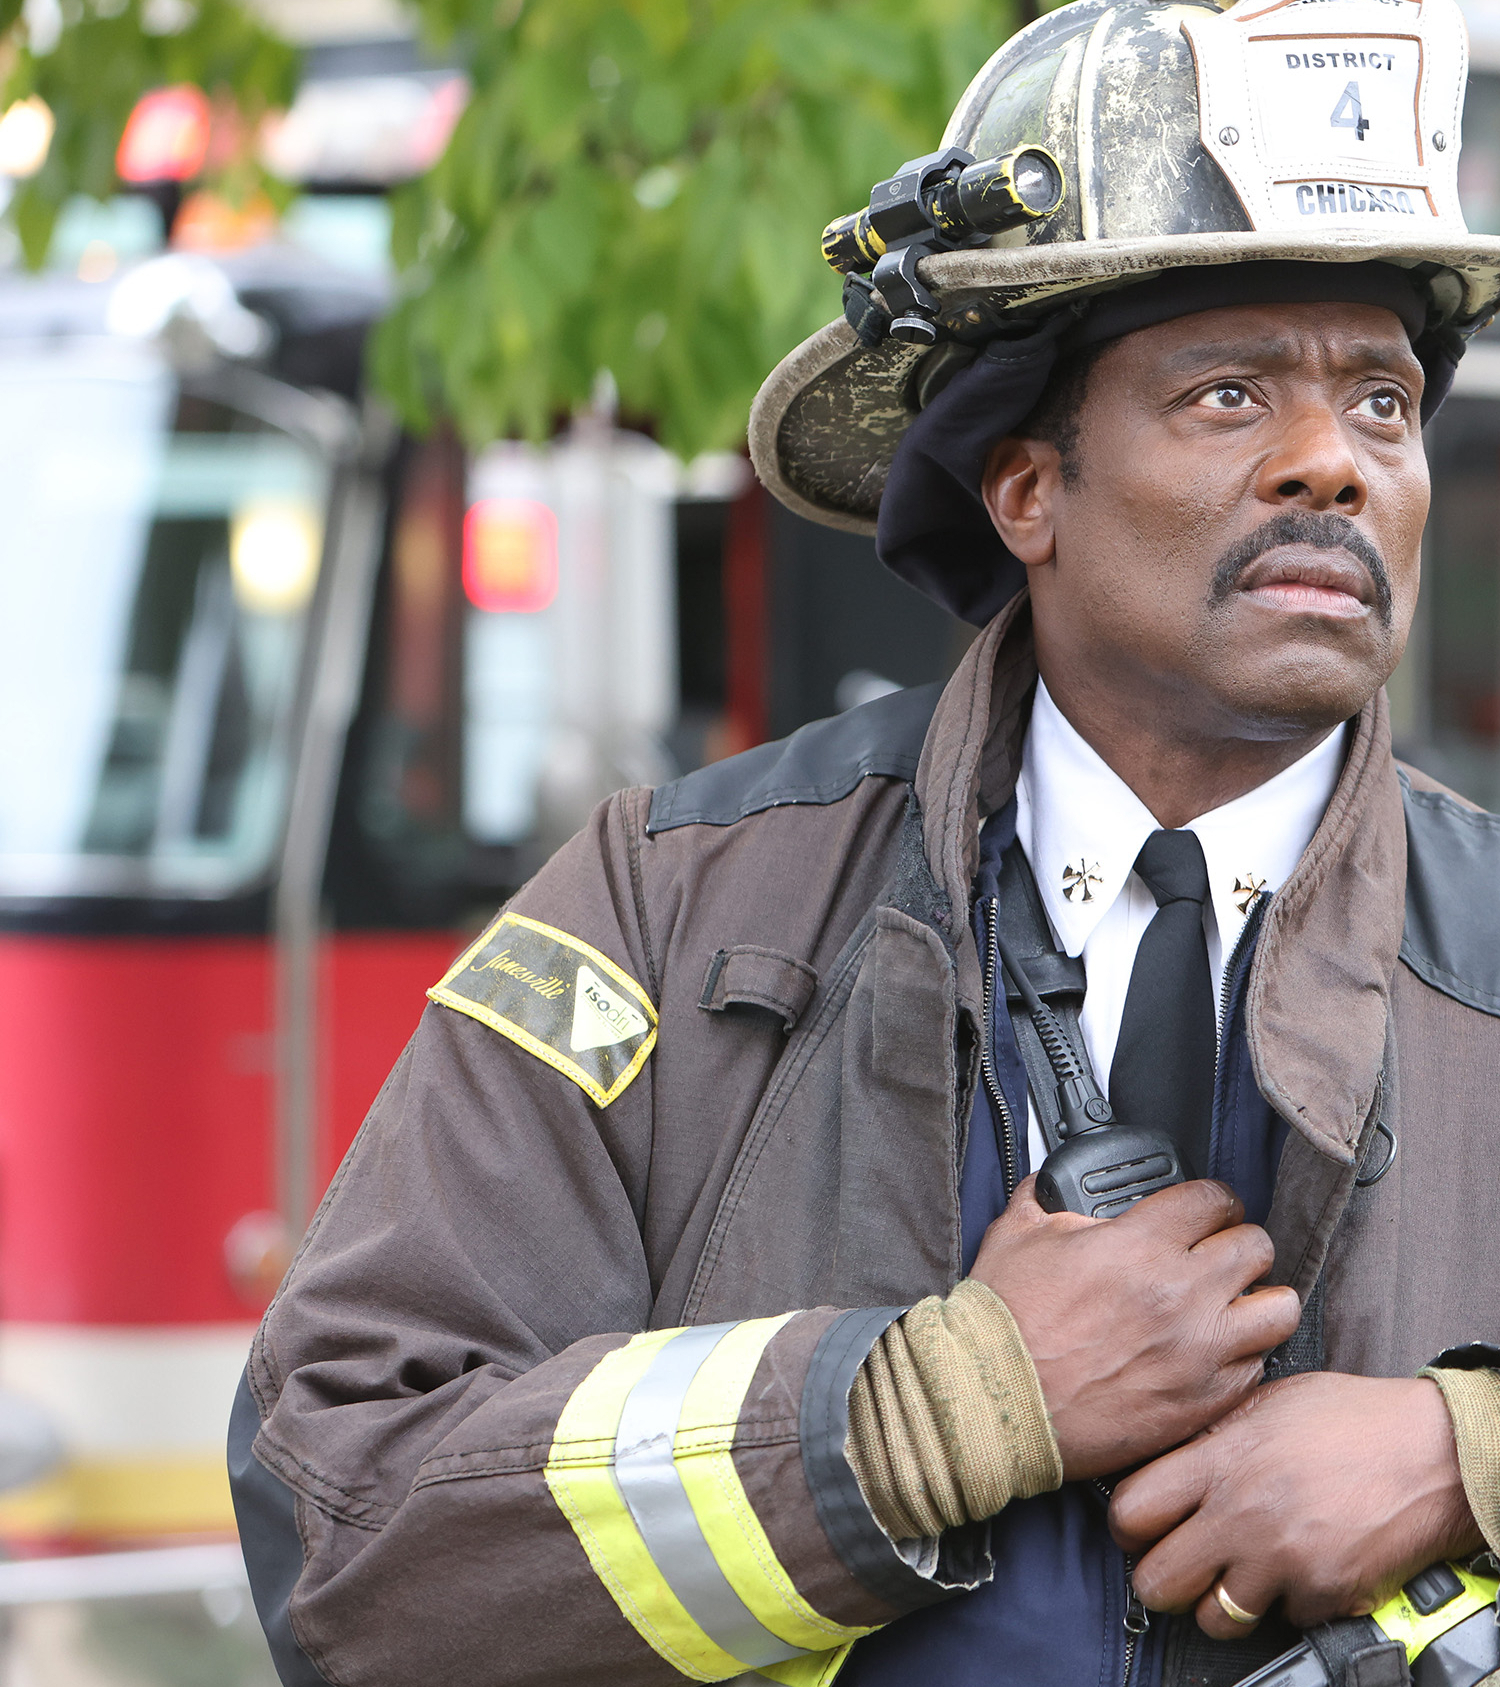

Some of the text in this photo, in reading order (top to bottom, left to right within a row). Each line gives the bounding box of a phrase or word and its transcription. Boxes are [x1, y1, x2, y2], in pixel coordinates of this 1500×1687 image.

[1285, 52, 1396, 71] DISTRICT
[1330, 81, 1370, 141] 4
[1296, 184, 1415, 215] CHICAGO
[470, 949, 571, 999] Janesville
[585, 981, 638, 1030] isodri
